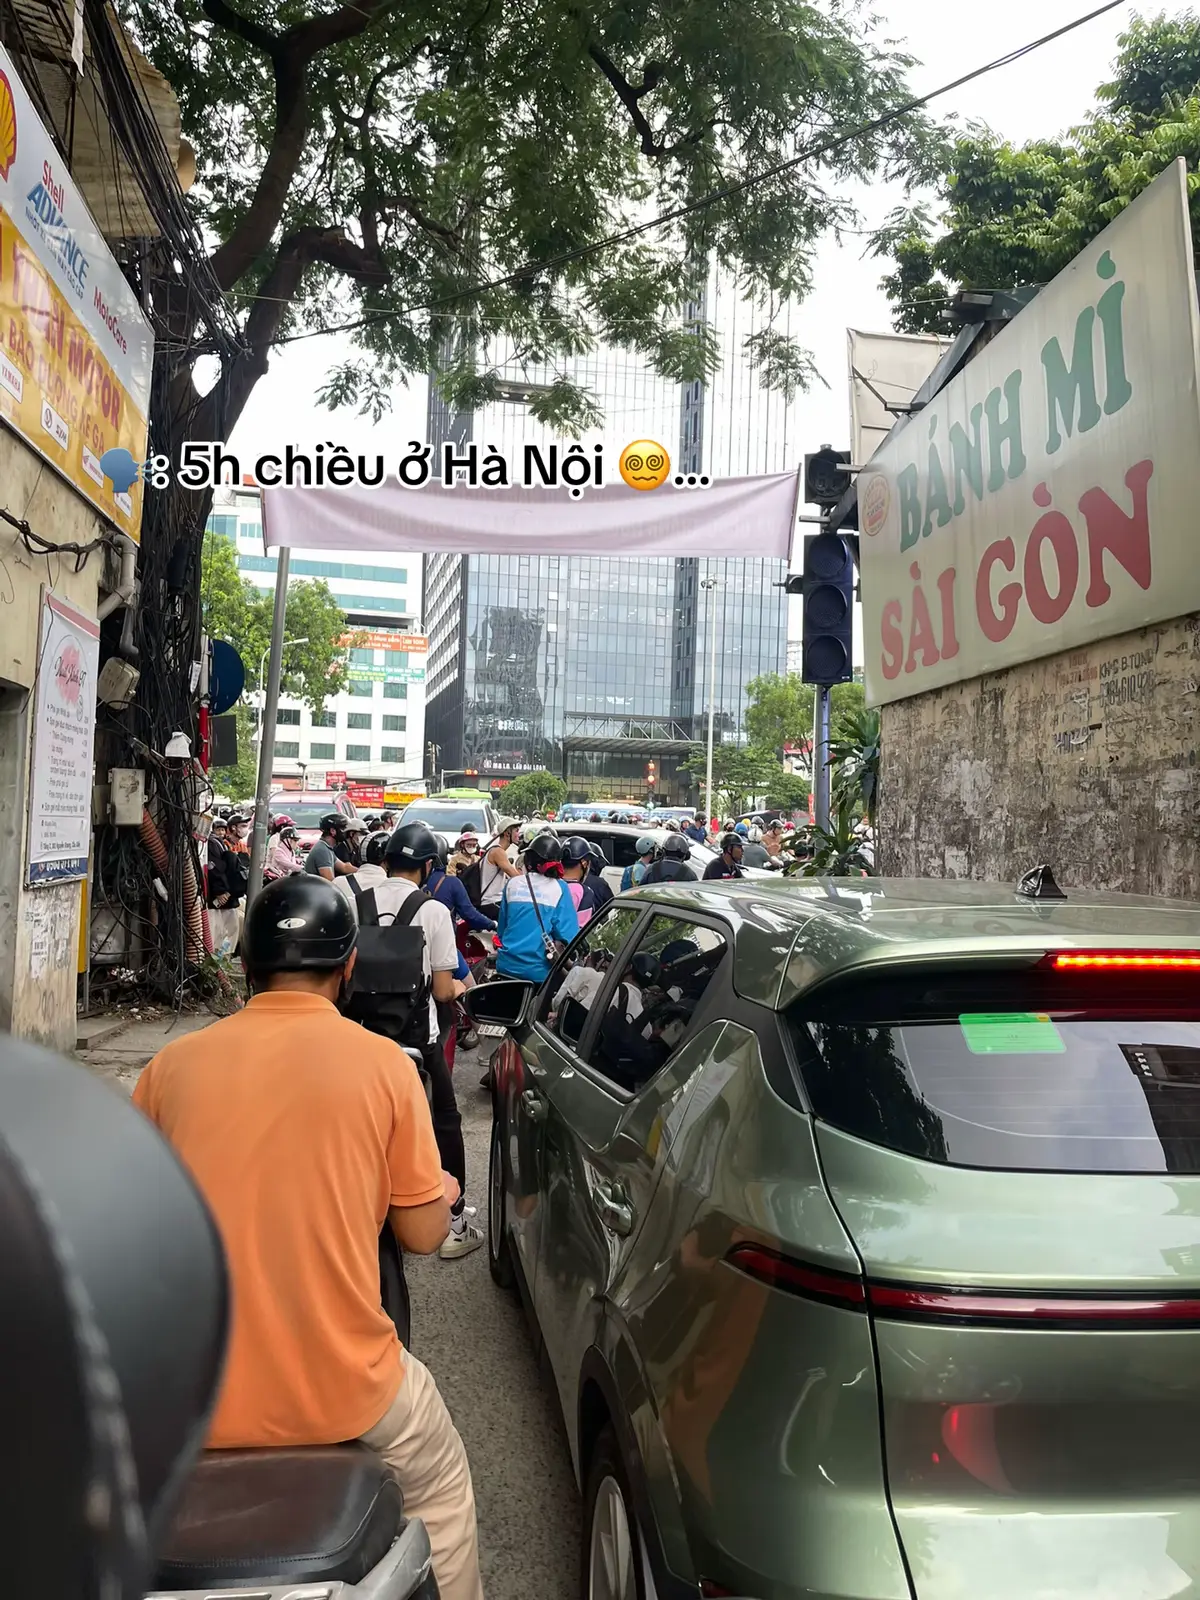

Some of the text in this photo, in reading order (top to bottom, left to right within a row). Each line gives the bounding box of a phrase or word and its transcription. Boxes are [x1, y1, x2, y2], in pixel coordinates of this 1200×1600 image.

[42, 159, 65, 214] Shell
[93, 286, 128, 355] MotoCare
[68, 330, 121, 433] MOTOR
[896, 249, 1132, 554] BÁNH MÌ
[55, 424, 67, 443] SYM
[880, 459, 1154, 681] SÀI GÒN
